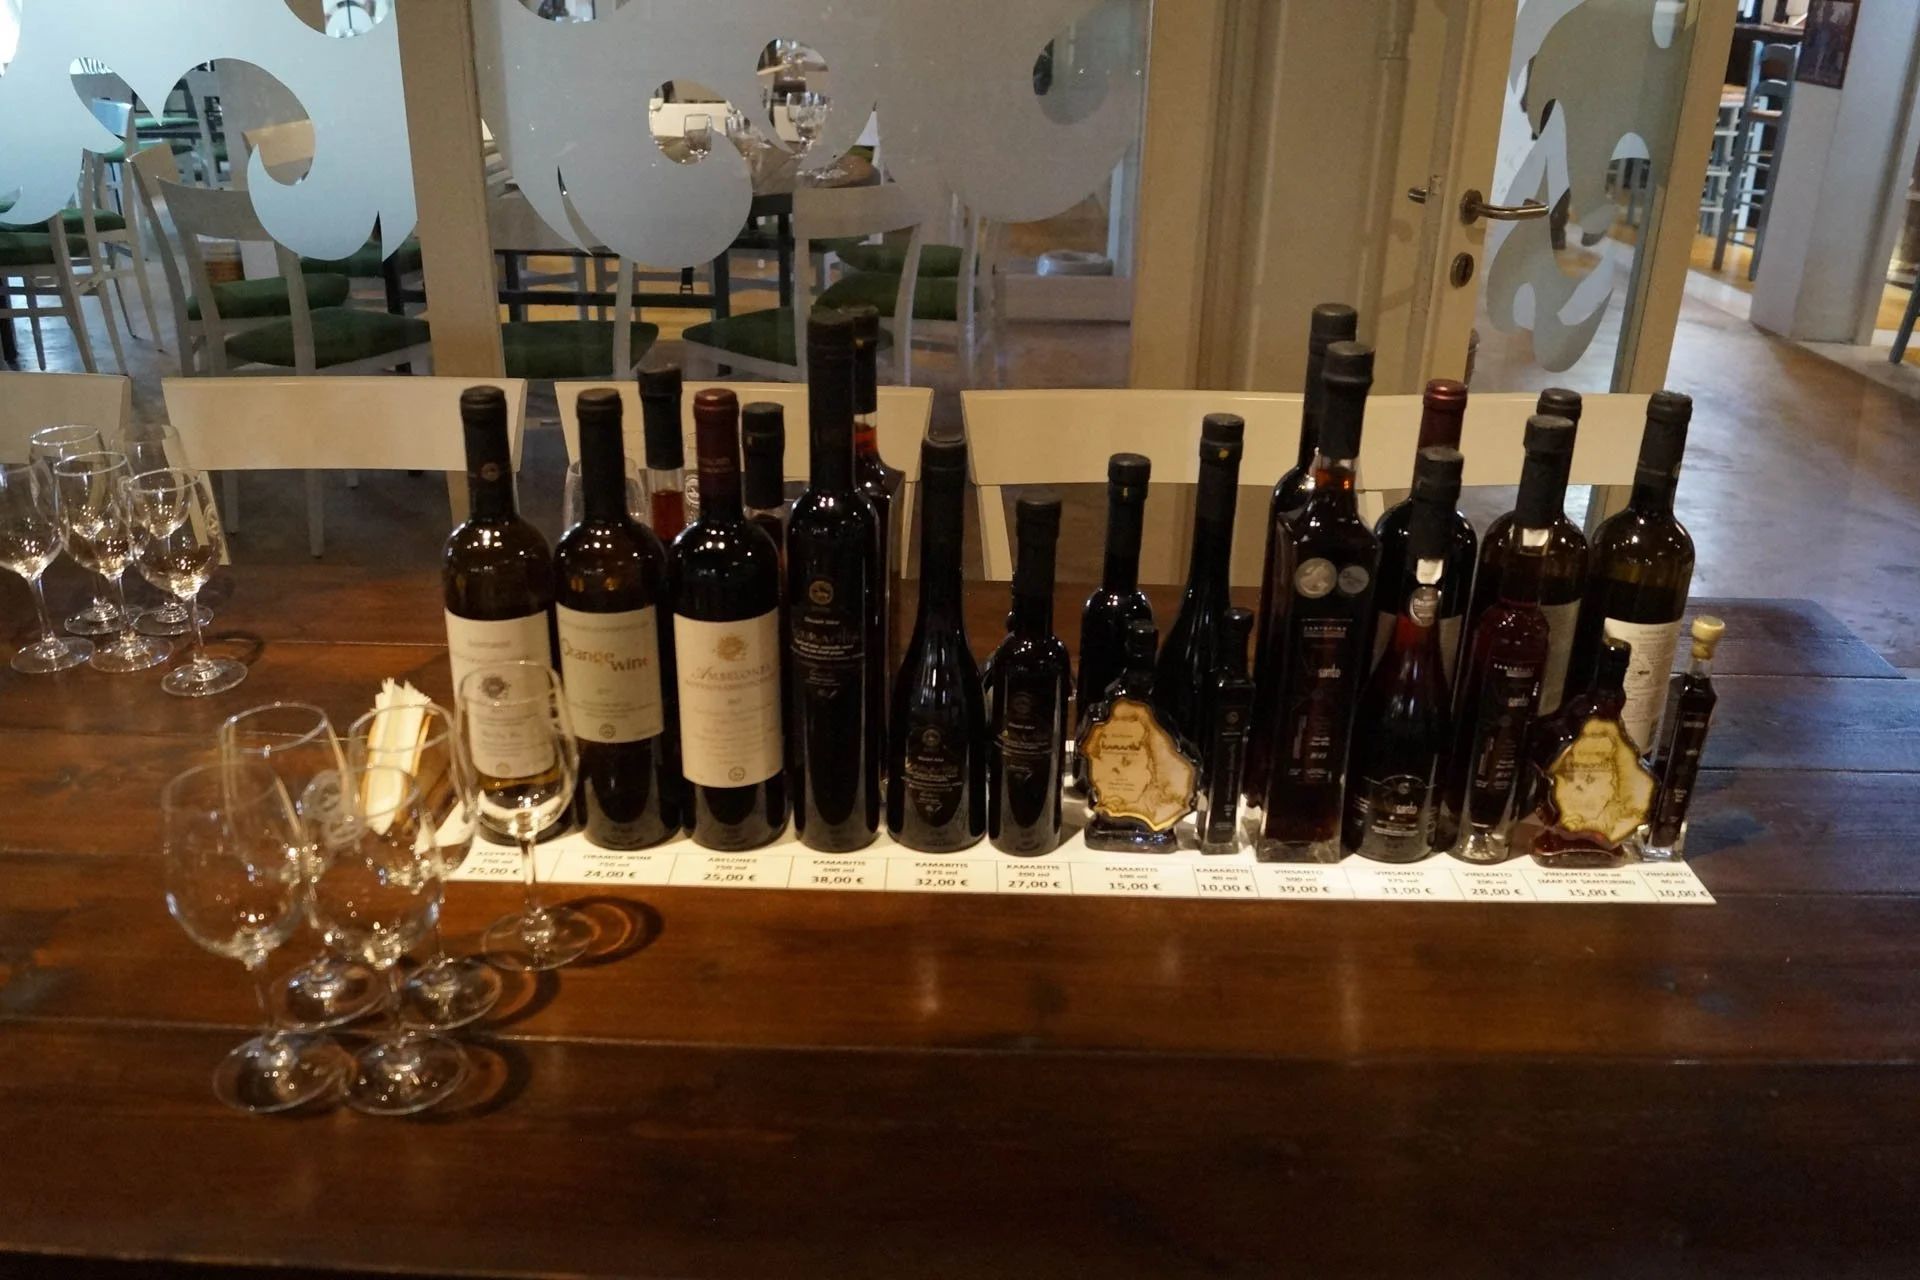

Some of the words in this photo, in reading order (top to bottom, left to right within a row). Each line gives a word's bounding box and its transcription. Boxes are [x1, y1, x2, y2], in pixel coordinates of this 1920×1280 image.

[467, 866, 508, 876] 25,00
[512, 867, 521, 875] €
[583, 869, 624, 879] 24,00
[628, 871, 638, 879] €
[703, 873, 744, 882] 25,00
[811, 875, 852, 884] 38,00
[856, 876, 865, 884] €
[914, 878, 956, 887] 32,00
[960, 878, 969, 886] €
[1008, 880, 1049, 889] 27,00
[1052, 880, 1062, 888] €
[1108, 882, 1149, 891] 15,00
[1153, 882, 1162, 890] €
[1201, 884, 1241, 892] 10,00
[1244, 884, 1254, 892] €
[1278, 885, 1319, 894] 39,00
[1381, 887, 1422, 895] 33,00
[1425, 887, 1435, 895] €
[1471, 887, 1511, 896] 28,00
[1514, 888, 1524, 896] €
[1568, 888, 1608, 896] 15,00
[1611, 888, 1621, 896] €
[1658, 889, 1697, 898] 10,00
[1700, 889, 1710, 897] €
